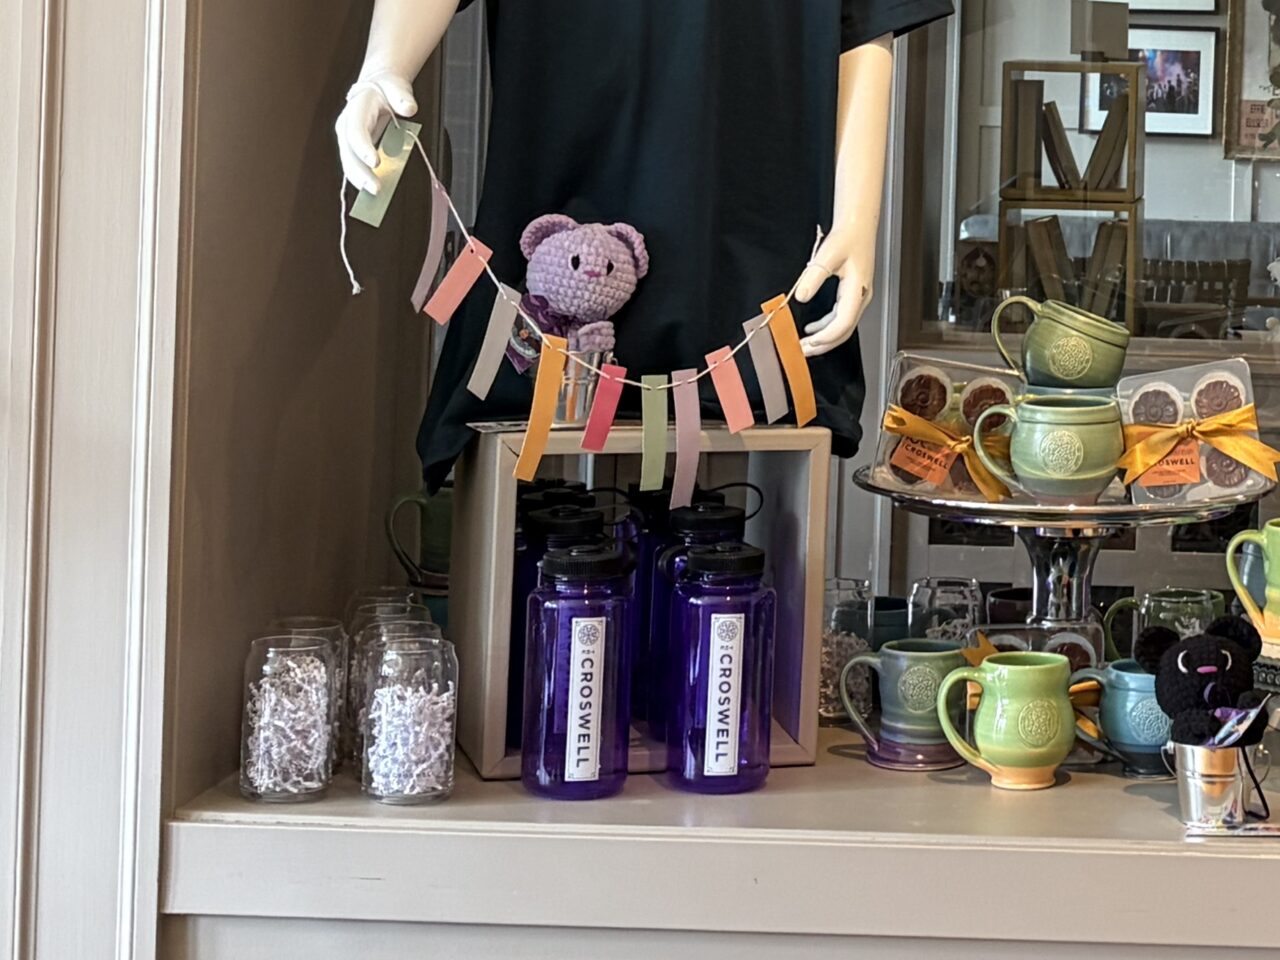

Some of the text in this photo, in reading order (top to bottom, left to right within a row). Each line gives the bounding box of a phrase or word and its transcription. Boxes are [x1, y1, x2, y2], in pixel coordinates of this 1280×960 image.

[904, 442, 948, 469] CROSWELL
[1155, 457, 1195, 467] OSWELL
[576, 657, 595, 768] CROSWELL
[714, 653, 733, 763] CROSWELL
